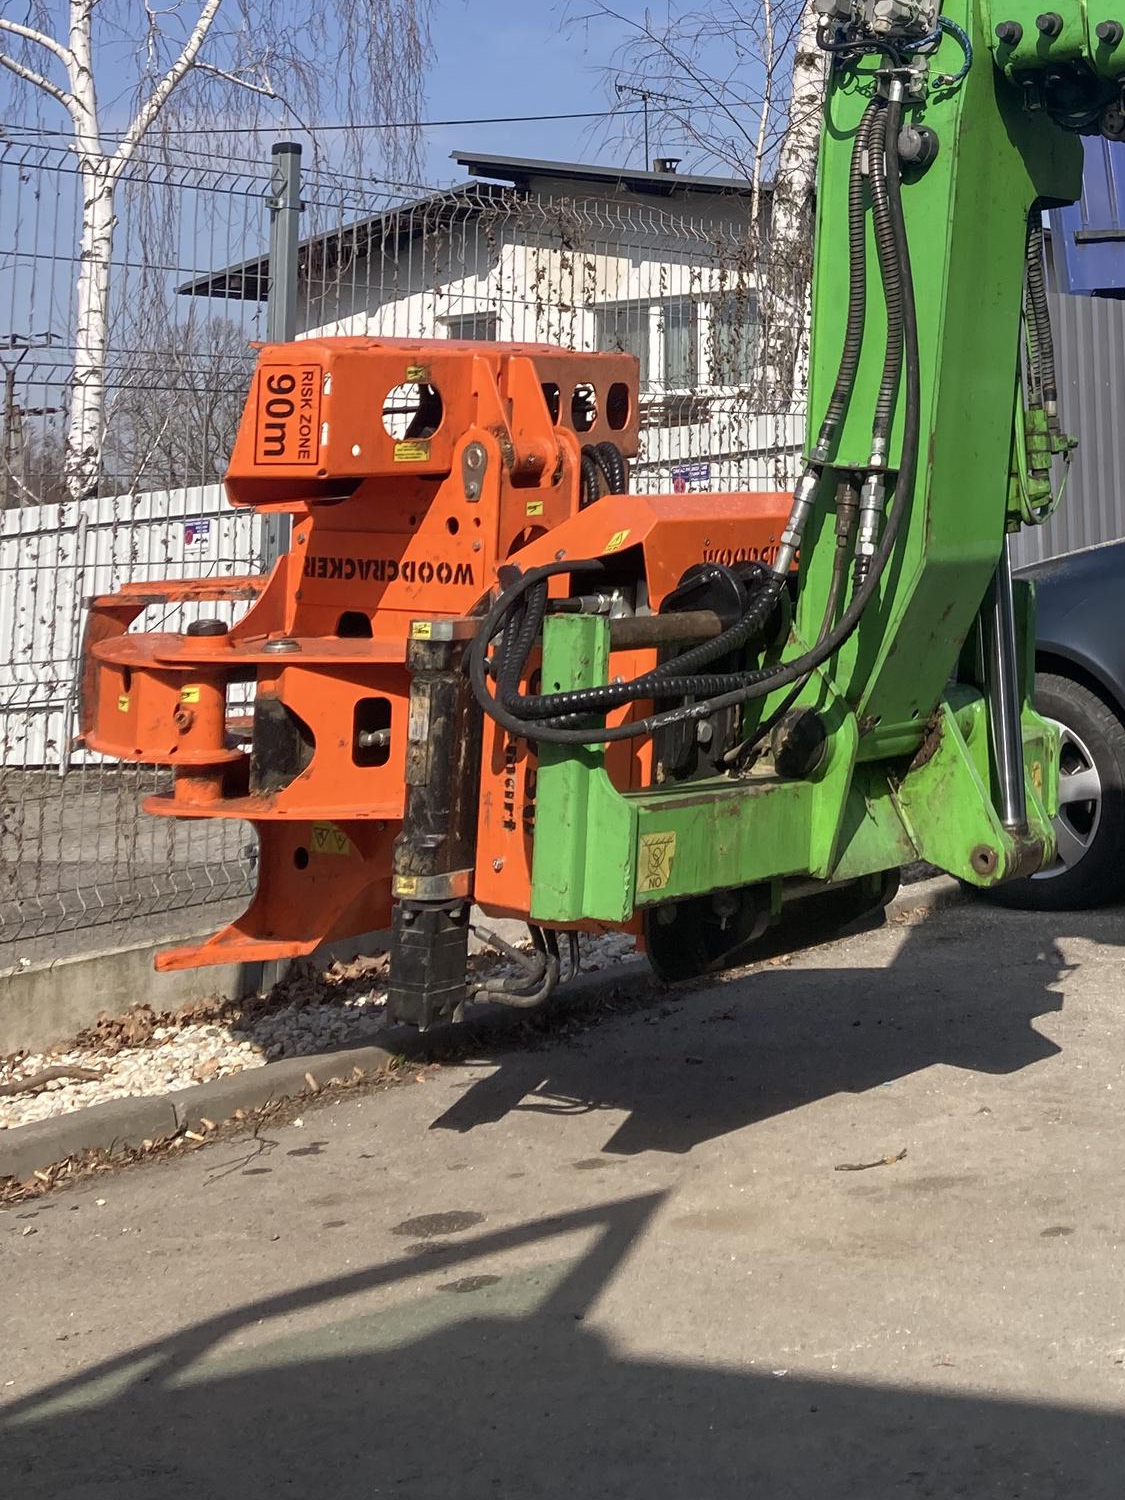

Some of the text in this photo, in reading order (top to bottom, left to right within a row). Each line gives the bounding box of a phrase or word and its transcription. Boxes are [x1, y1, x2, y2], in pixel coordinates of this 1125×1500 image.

[263, 374, 296, 457] 90m
[297, 371, 314, 460] RISK ZONE
[304, 556, 475, 586] WOODCRACKER
[648, 877, 662, 889] NO
